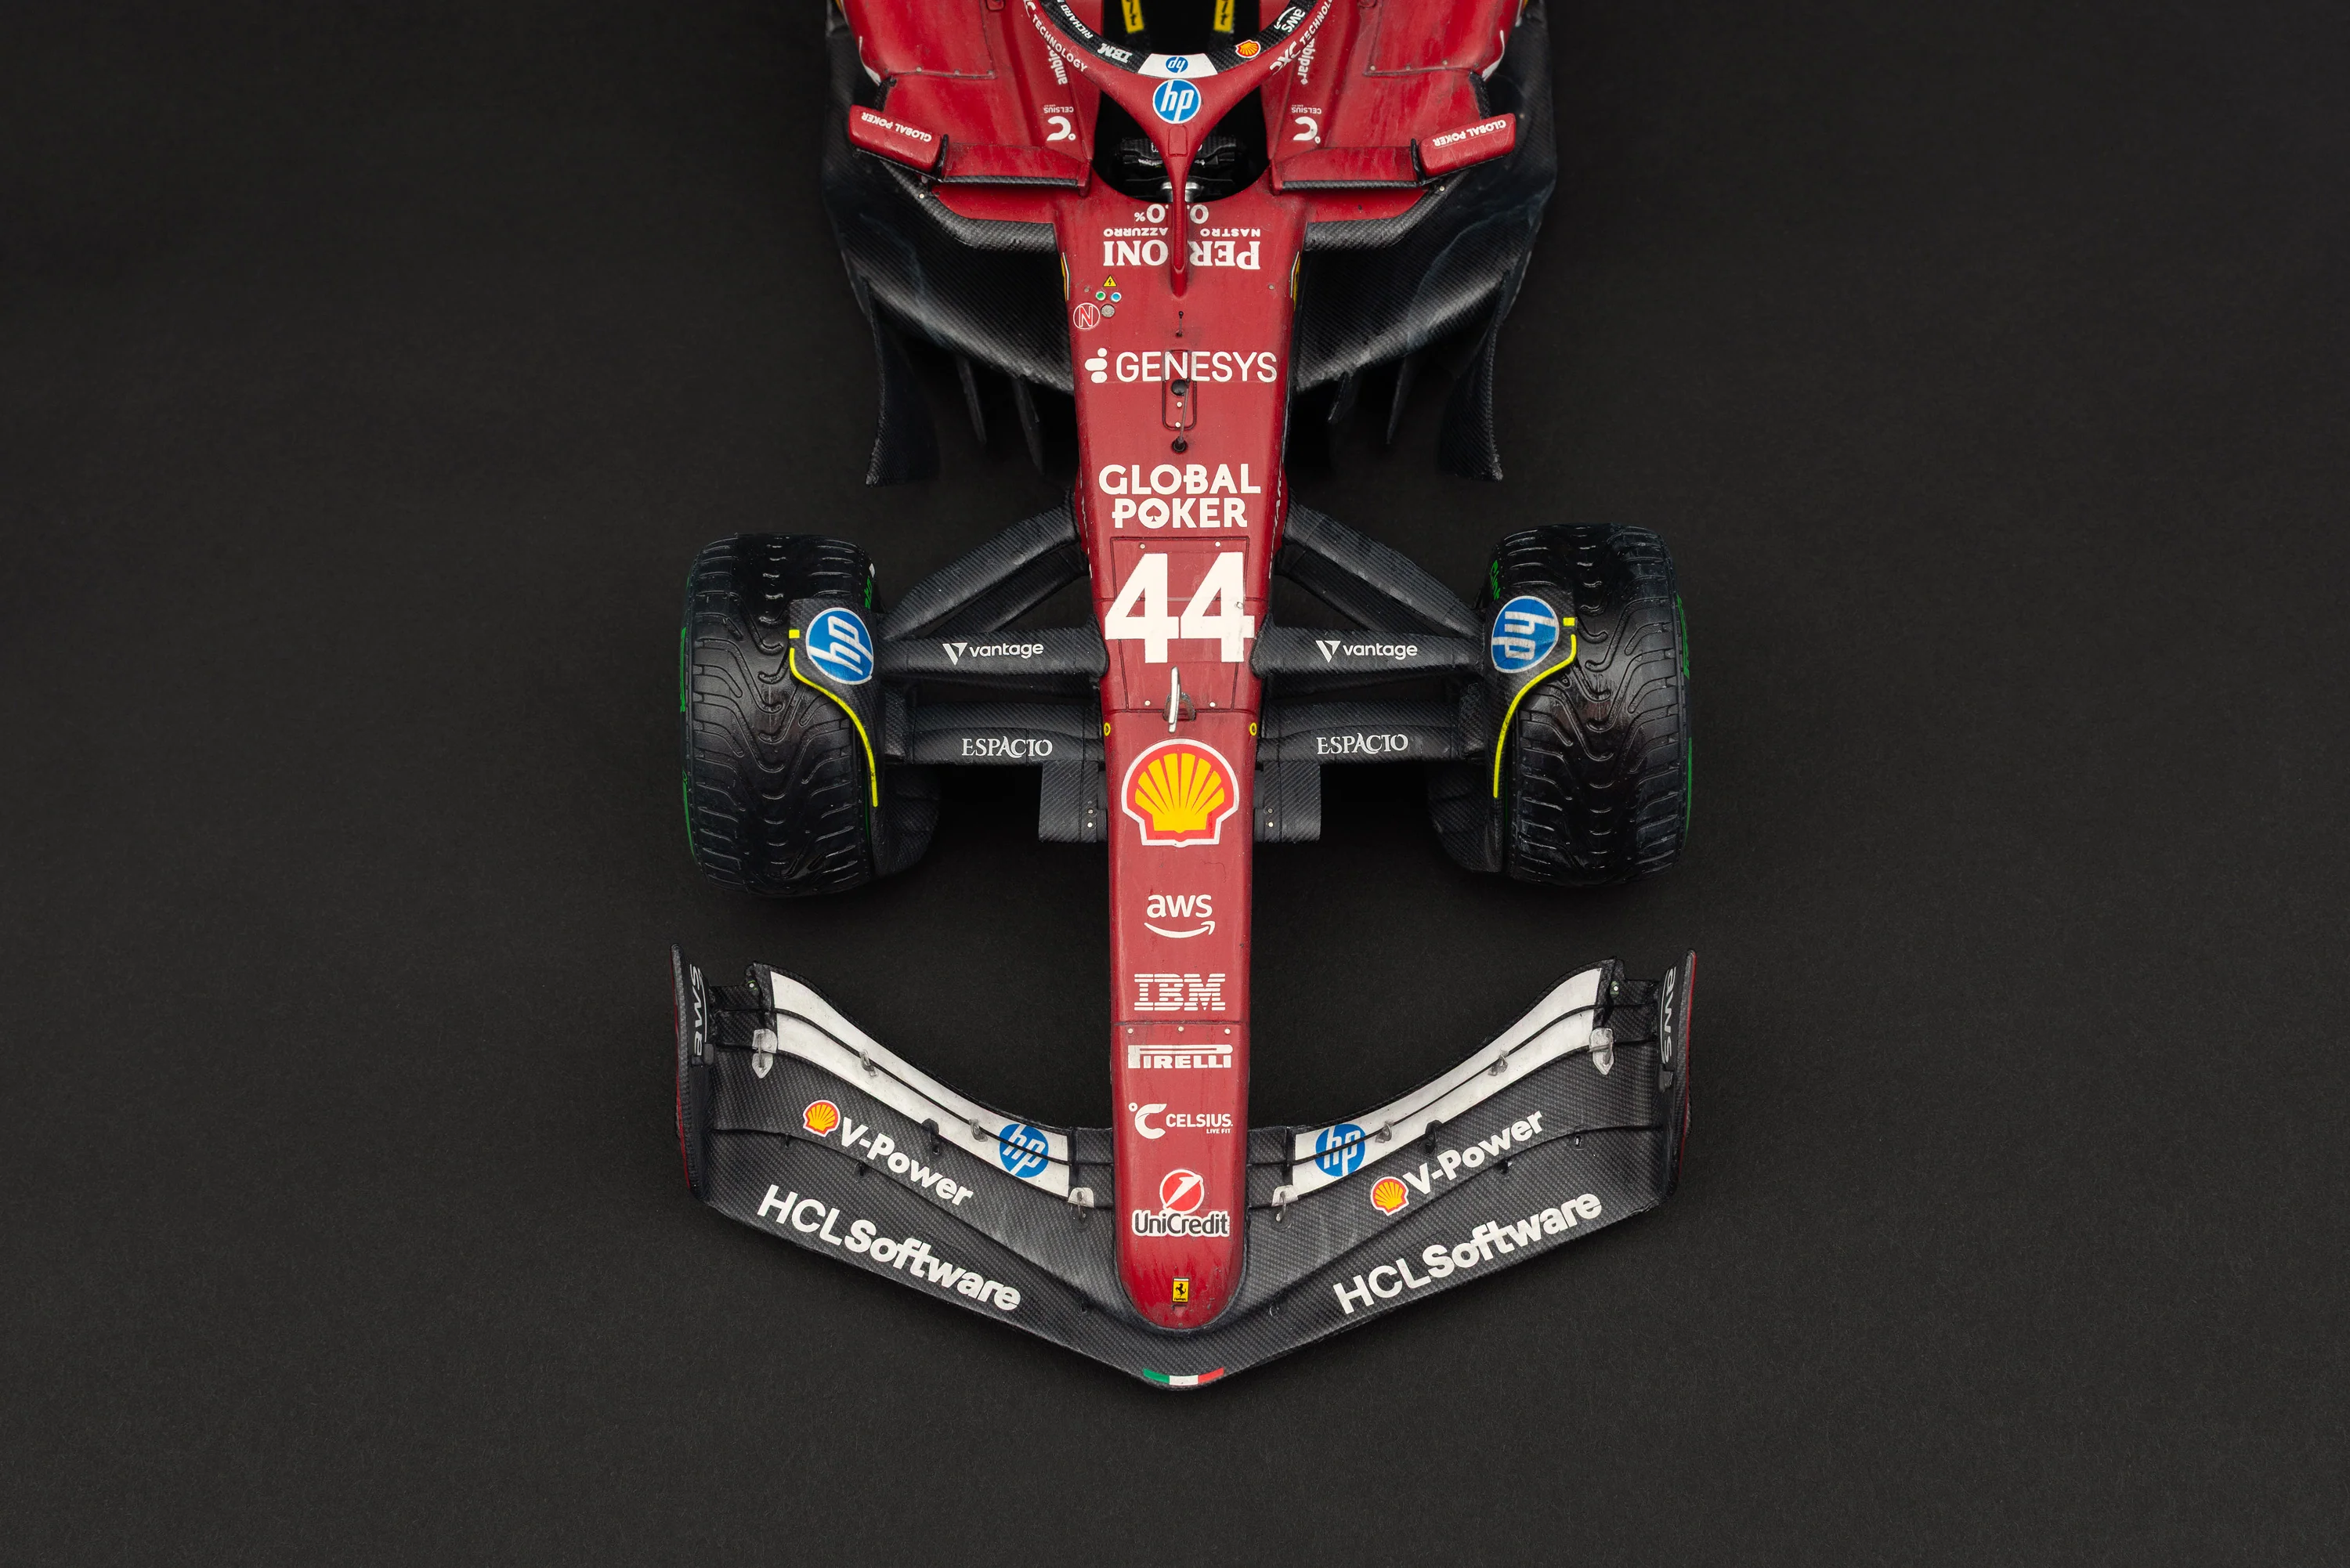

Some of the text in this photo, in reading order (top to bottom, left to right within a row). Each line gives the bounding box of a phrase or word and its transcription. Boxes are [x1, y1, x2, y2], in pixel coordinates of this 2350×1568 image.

[1061, 4, 1094, 39] RICHARD
[1282, 8, 1306, 33] aws
[1032, 13, 1088, 72] TECHNOLOGY
[1097, 42, 1133, 63] IBM
[1167, 56, 1187, 74] hp
[1043, 106, 1075, 114] CELSIUS
[1159, 80, 1195, 123] hp
[1291, 107, 1322, 115] CELSIUS
[861, 112, 932, 143] GLOBAL POKER
[1432, 119, 1506, 147] GLOBAL POKER
[1103, 227, 1261, 237] NASTRO AZZURRO
[1115, 351, 1278, 383] GENESYS
[1098, 463, 1261, 496] GLOBAL
[1112, 497, 1248, 529] POKER
[1104, 551, 1255, 663] 44
[807, 616, 873, 677] hp
[969, 641, 1044, 659] vantage
[1342, 641, 1419, 661] vantage
[1491, 610, 1557, 661] hp
[961, 735, 1053, 759] ESPACIO
[1316, 733, 1409, 755] ESPACIO
[1146, 894, 1213, 918] aws
[1133, 973, 1226, 1011] IBM
[689, 963, 703, 1056] aws
[1664, 966, 1676, 1063] aws
[1127, 1044, 1234, 1069] PIRELLI
[839, 1117, 974, 1206] V-Power
[1002, 1123, 1047, 1177] hp
[1320, 1123, 1361, 1177] hp
[1408, 1110, 1543, 1195] V-Power
[1134, 1213, 1229, 1235] UniCredit
[756, 1183, 1021, 1312] HCLSoftware
[1332, 1192, 1603, 1314] HCLSoftware
